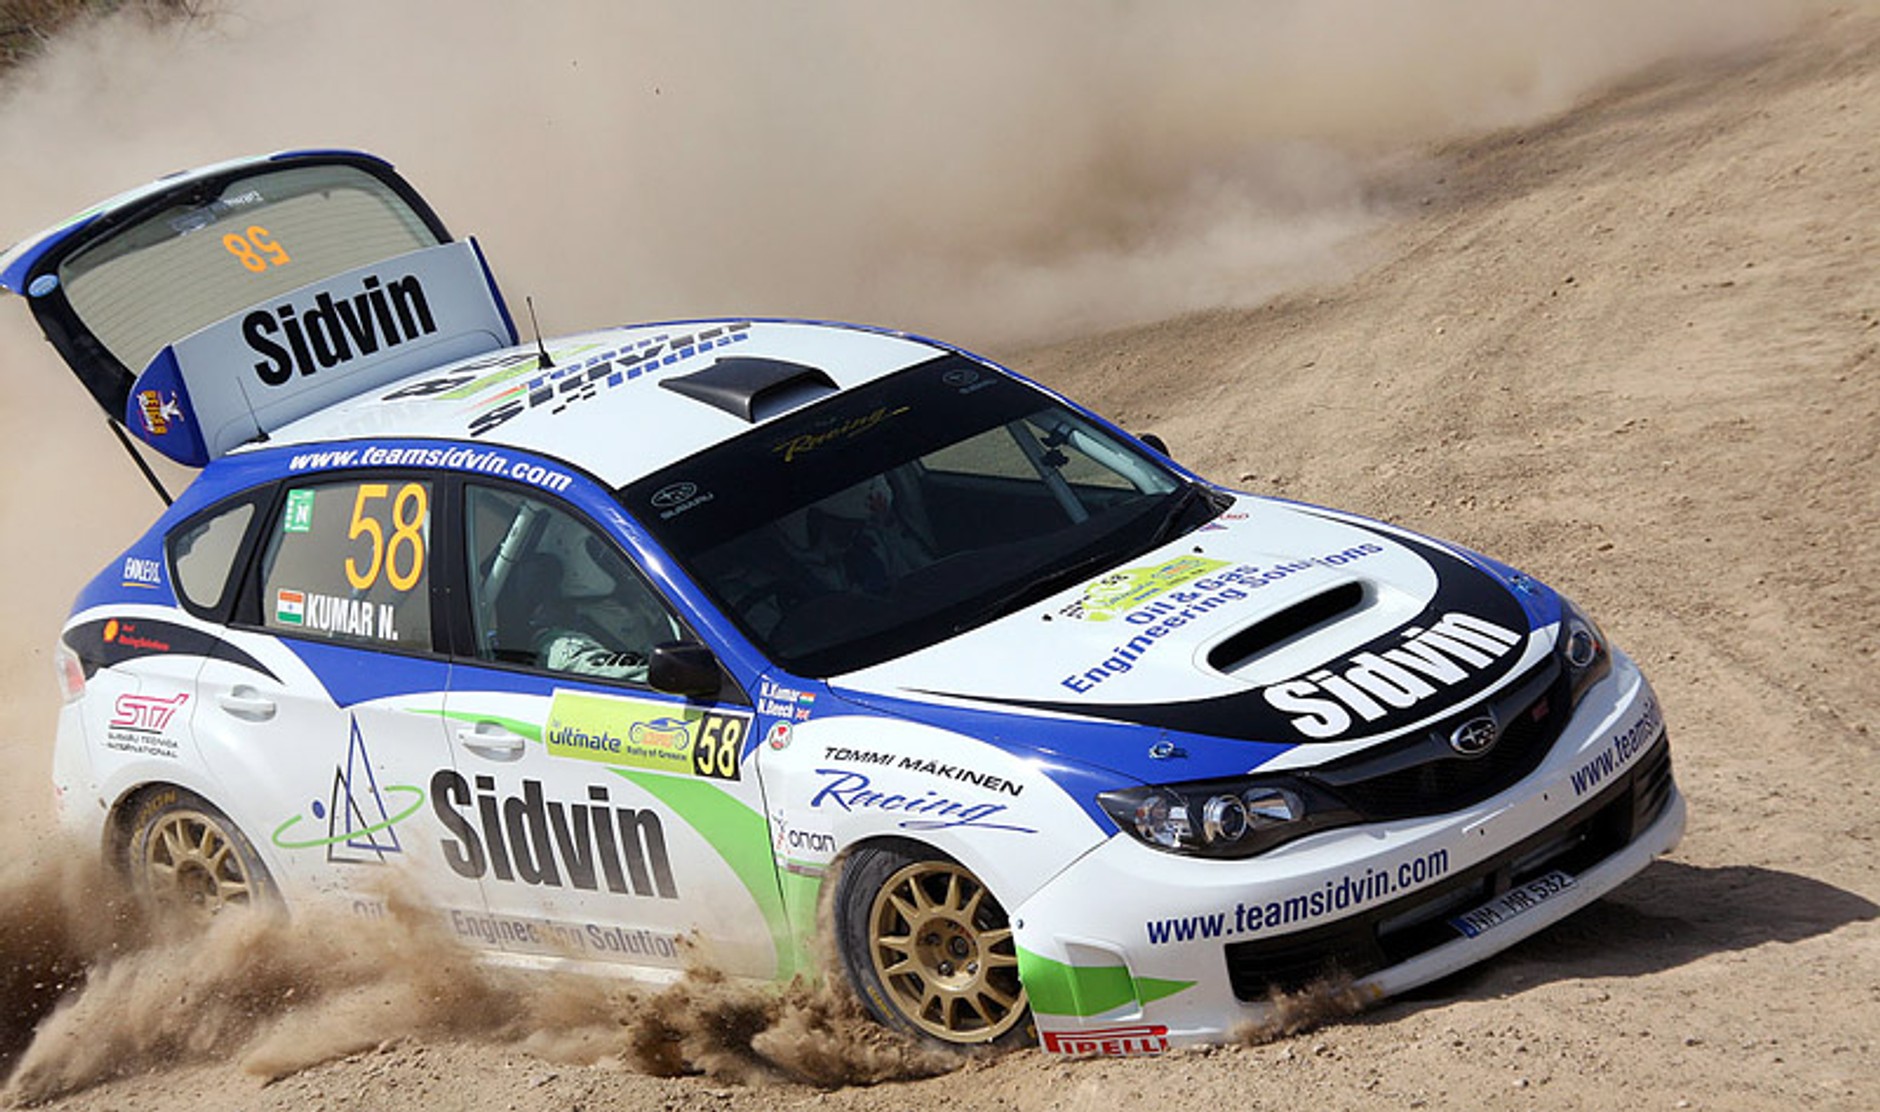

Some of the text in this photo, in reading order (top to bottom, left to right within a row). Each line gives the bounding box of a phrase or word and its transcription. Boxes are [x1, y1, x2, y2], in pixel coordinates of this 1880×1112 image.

[223, 225, 290, 273] 58
[241, 273, 436, 387] Sidvin
[288, 446, 573, 492] www.teamsidvin.com
[345, 483, 428, 592] 58
[305, 592, 399, 641] KUMAR N.
[1125, 601, 1176, 625] Oil
[1169, 592, 1202, 603] &
[1194, 564, 1258, 591] Gas
[1061, 585, 1247, 694] Engineering
[1263, 612, 1523, 739] Sidvin
[549, 727, 622, 754] ultimate
[698, 716, 741, 778] 58
[824, 747, 897, 766] TOMMI
[810, 769, 1039, 834] Racing
[430, 769, 679, 899] Sidvin
[1147, 848, 1449, 944] www.teamsidvin.com
[1042, 1025, 1168, 1054] PIRELLI
